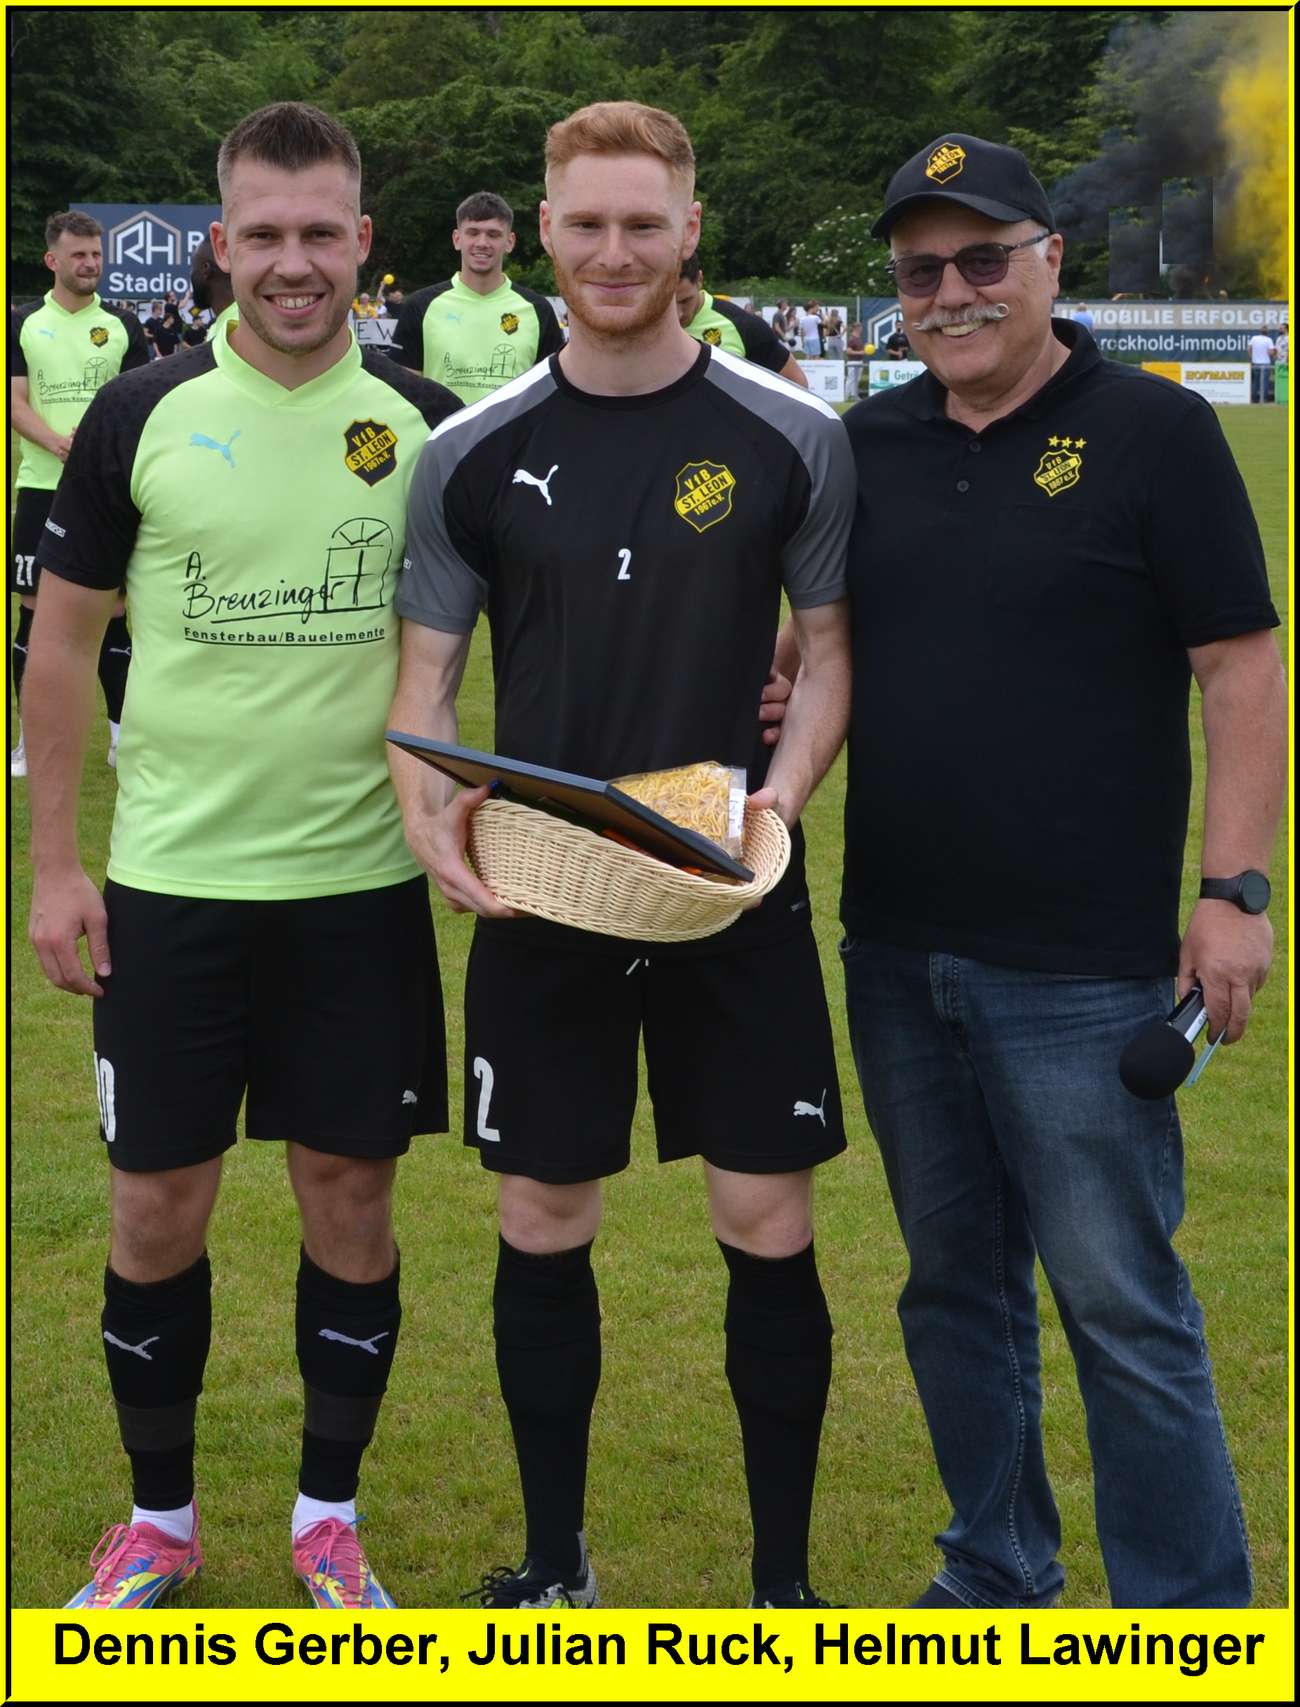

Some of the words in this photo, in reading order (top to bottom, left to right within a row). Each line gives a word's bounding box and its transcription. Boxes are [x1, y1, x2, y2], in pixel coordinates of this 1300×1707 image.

[117, 221, 173, 265] RH
[109, 272, 191, 293] Stadio
[352, 426, 376, 447] VfB
[366, 432, 393, 455] LEON
[684, 468, 711, 490] VfB
[700, 474, 729, 497] LEON
[186, 551, 207, 580] A.
[617, 548, 632, 580] 2
[184, 626, 386, 643] Fensterbau/Bauelemente
[473, 1056, 501, 1142] 2
